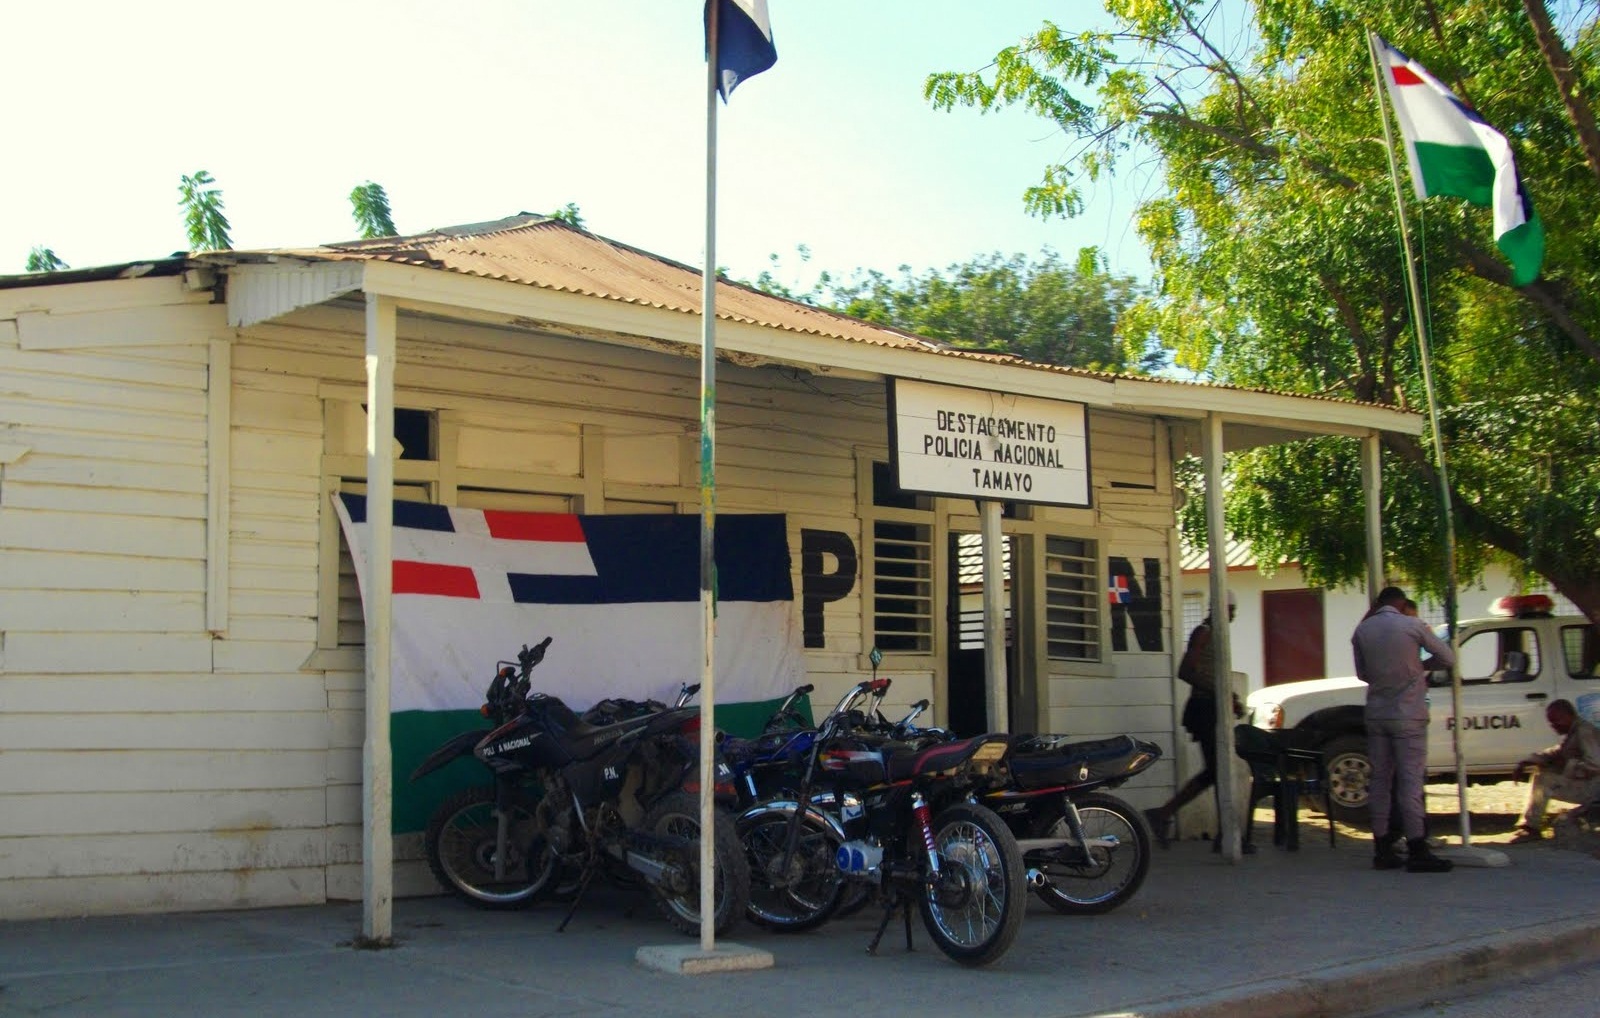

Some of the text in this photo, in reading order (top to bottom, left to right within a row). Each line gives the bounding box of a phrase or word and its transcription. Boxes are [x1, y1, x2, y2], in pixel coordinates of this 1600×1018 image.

[937, 410, 1055, 443] DESTACAMENTO
[924, 434, 1064, 468] POLICIA NACIONAL
[973, 468, 1032, 492] TAMAYO
[801, 529, 1163, 652] P N
[503, 737, 531, 751] NACIONAL
